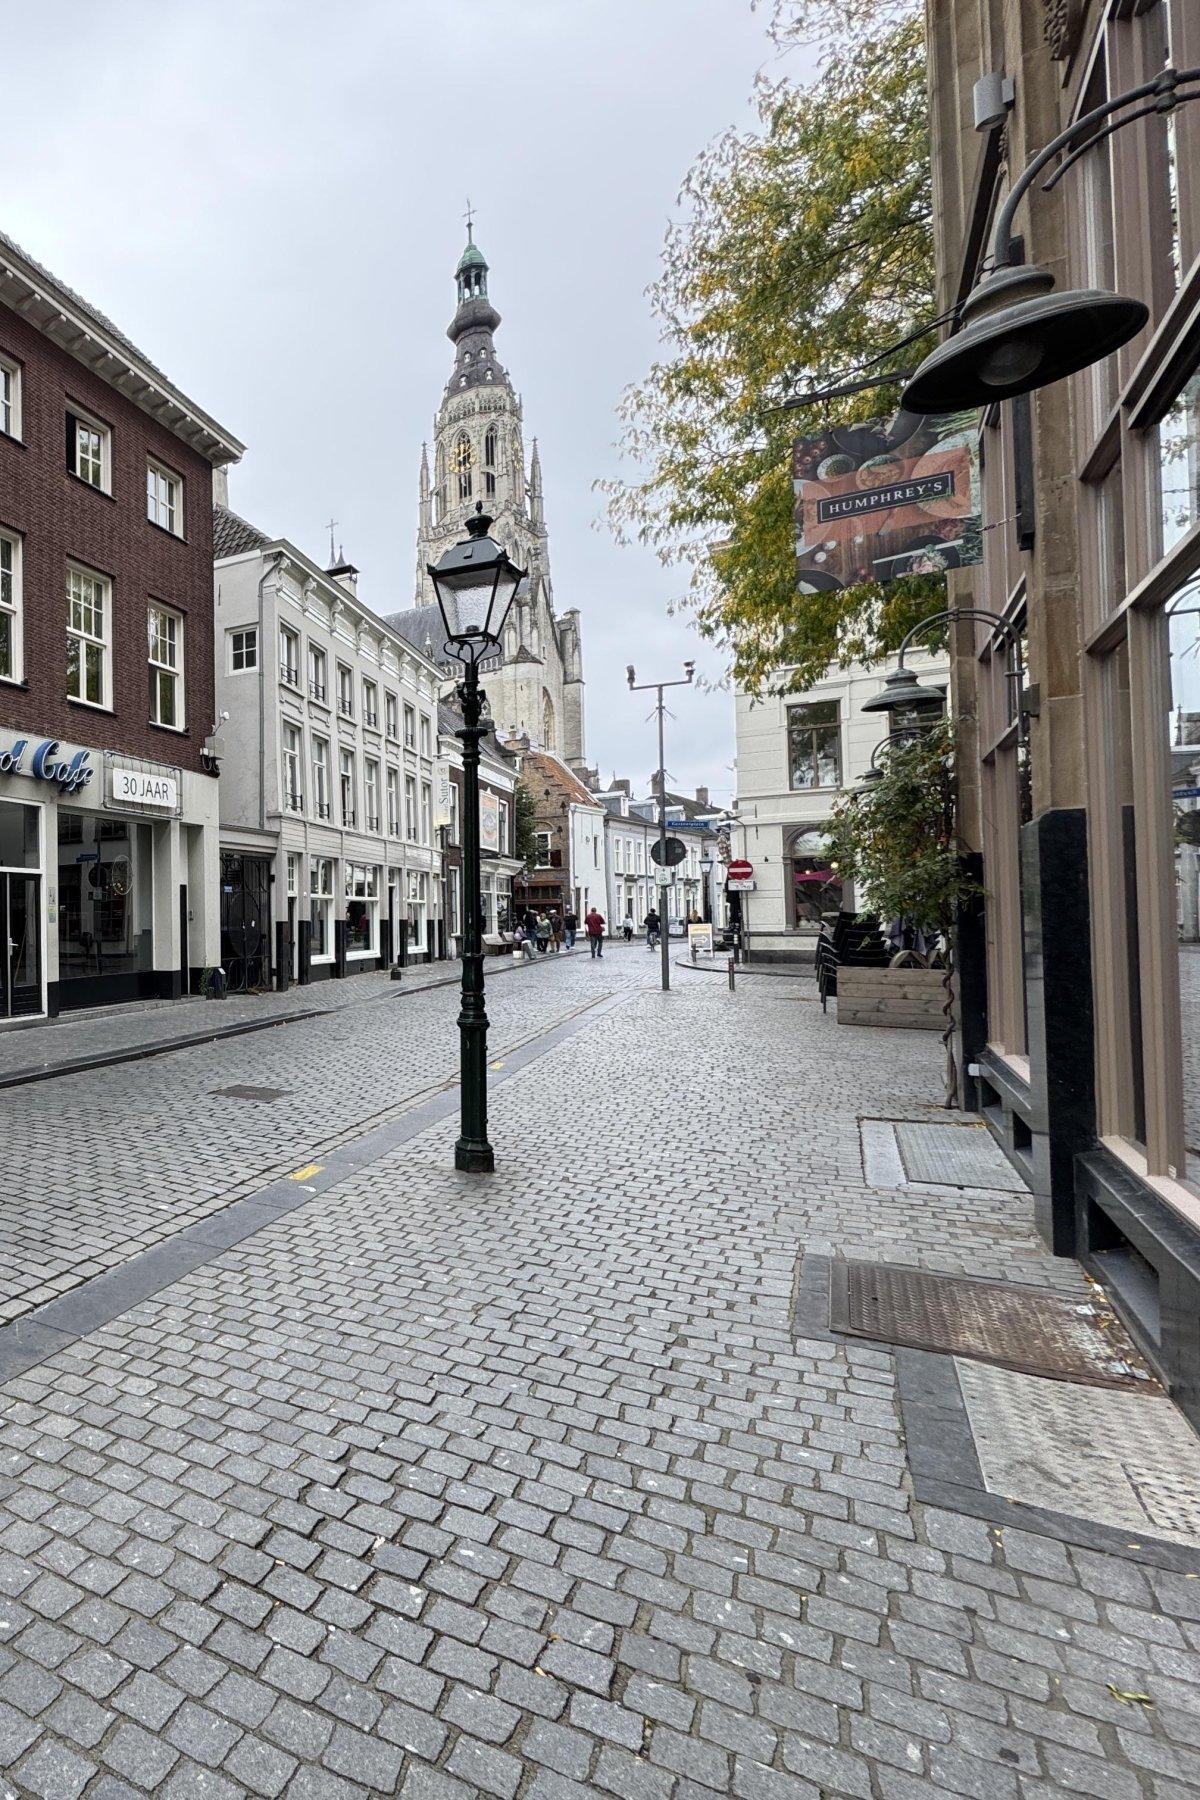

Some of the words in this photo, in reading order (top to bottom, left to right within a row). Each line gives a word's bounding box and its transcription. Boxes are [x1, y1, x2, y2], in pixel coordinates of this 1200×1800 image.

[829, 481, 943, 514] HUMPHREY'S
[122, 776, 137, 795] 30
[139, 778, 169, 800] JAAR
